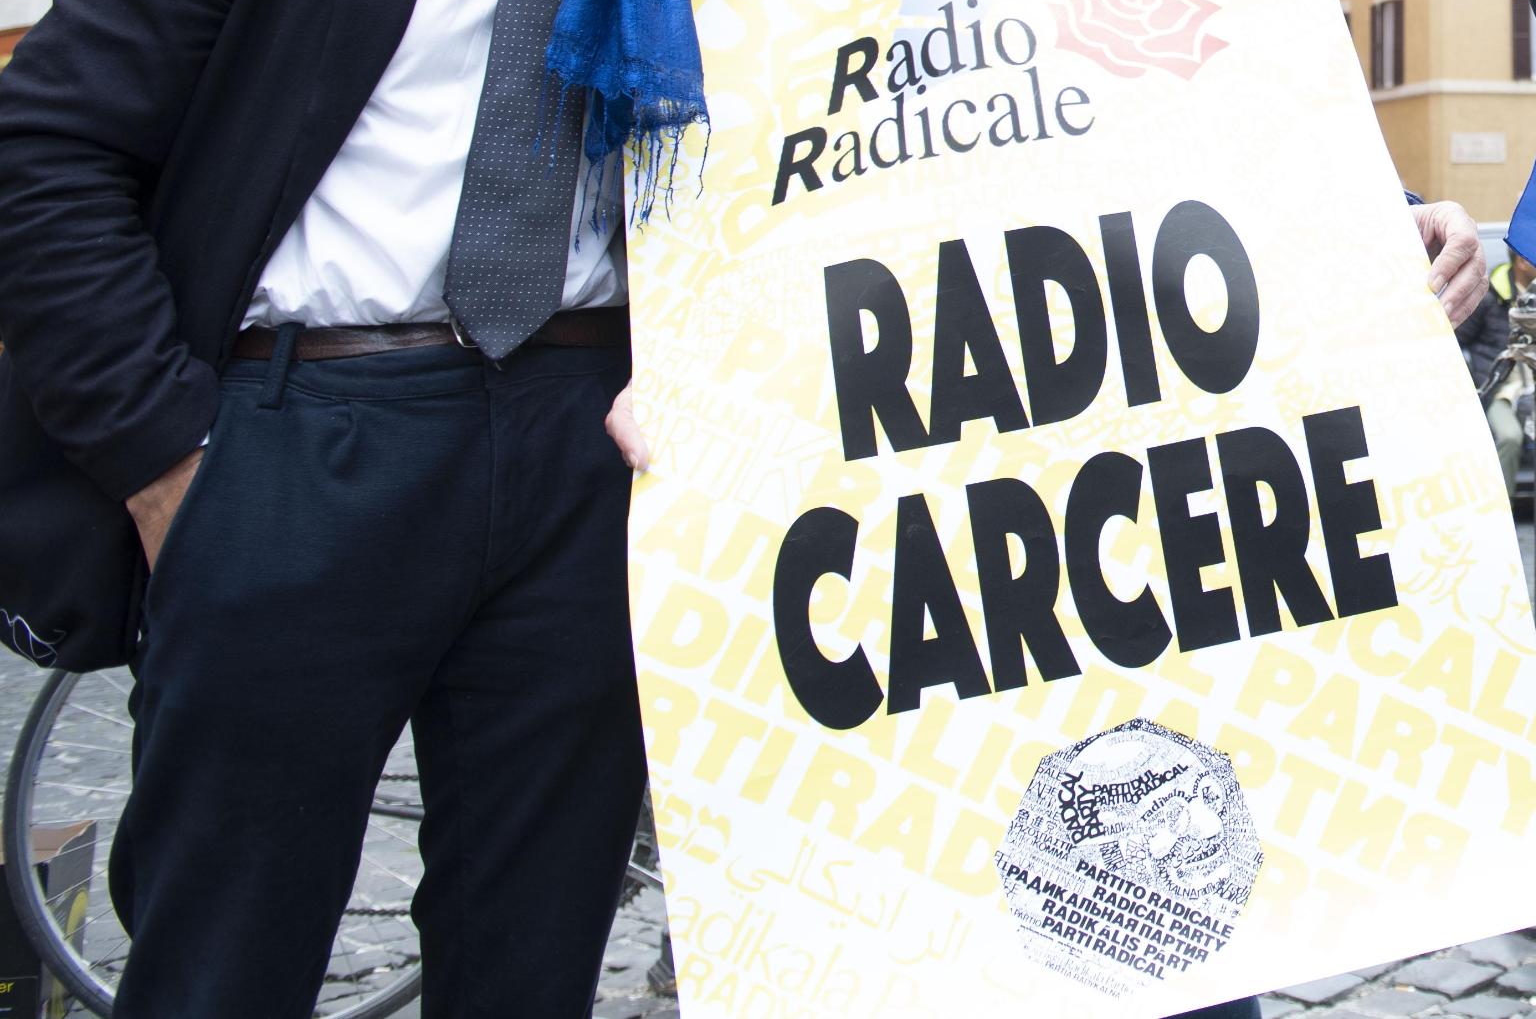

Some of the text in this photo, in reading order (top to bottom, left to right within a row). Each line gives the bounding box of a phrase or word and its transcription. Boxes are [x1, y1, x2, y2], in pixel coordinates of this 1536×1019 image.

[772, 69, 1097, 206] Radicale
[824, 200, 1260, 461] RADIO
[773, 406, 1398, 730] CARCERE
[1057, 770, 1085, 846] RADICAL
[1076, 784, 1106, 839] PARTY
[1075, 858, 1235, 940] PARTITO RADICALE
[1092, 885, 1228, 953] RADICAL PARTY
[1041, 916, 1166, 981] PARTI RADICAL
